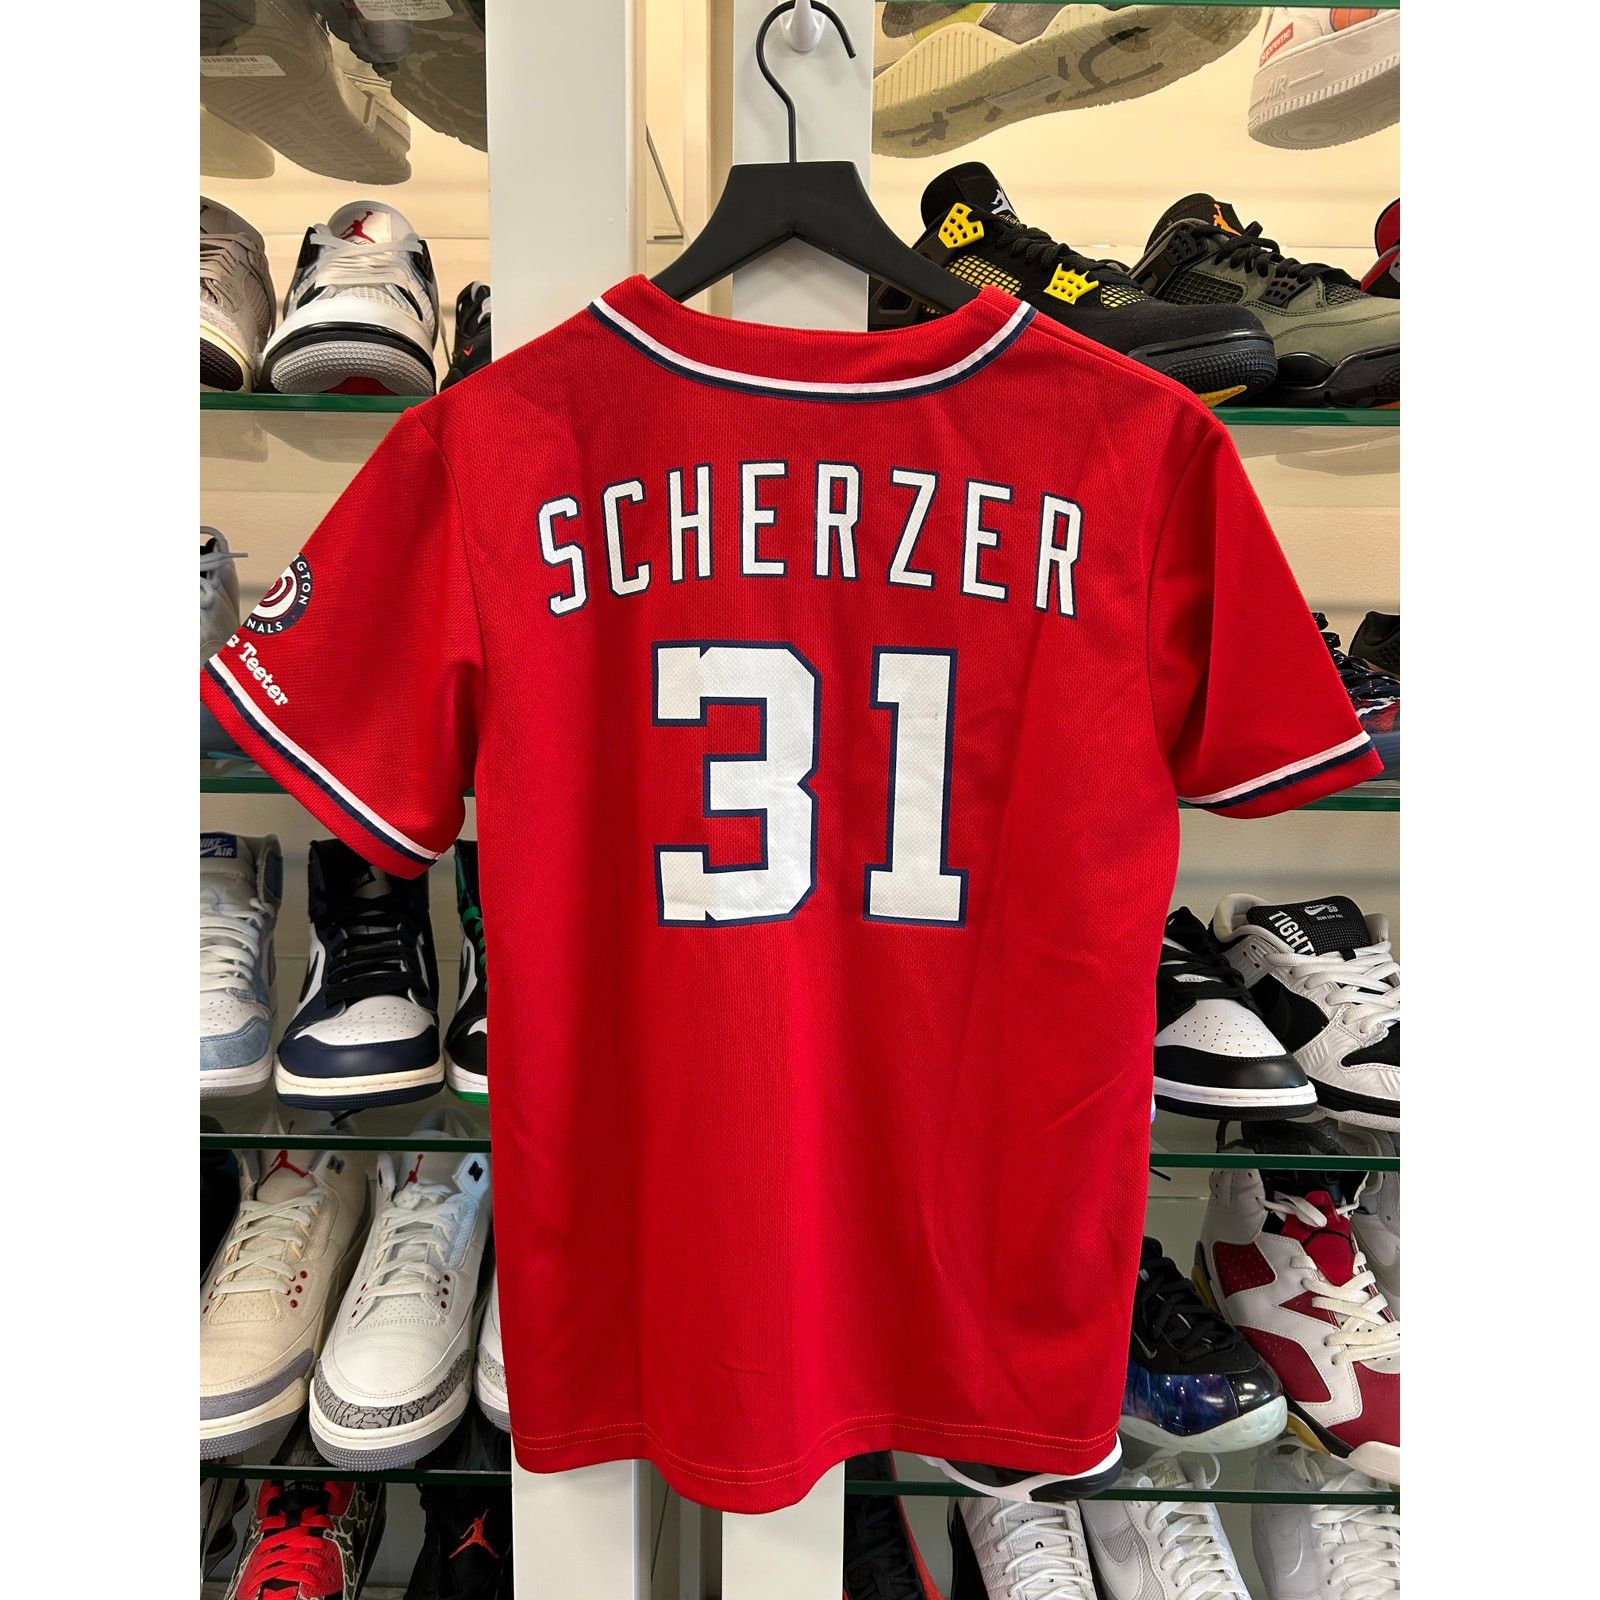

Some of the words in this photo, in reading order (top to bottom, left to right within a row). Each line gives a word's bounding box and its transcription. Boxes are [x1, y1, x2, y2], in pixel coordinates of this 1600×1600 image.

[537, 460, 1083, 619] SCHERZER
[239, 641, 289, 706] Teeter
[651, 638, 969, 928] 31
[214, 847, 234, 857] AIR
[1268, 910, 1317, 957] TIGHT
